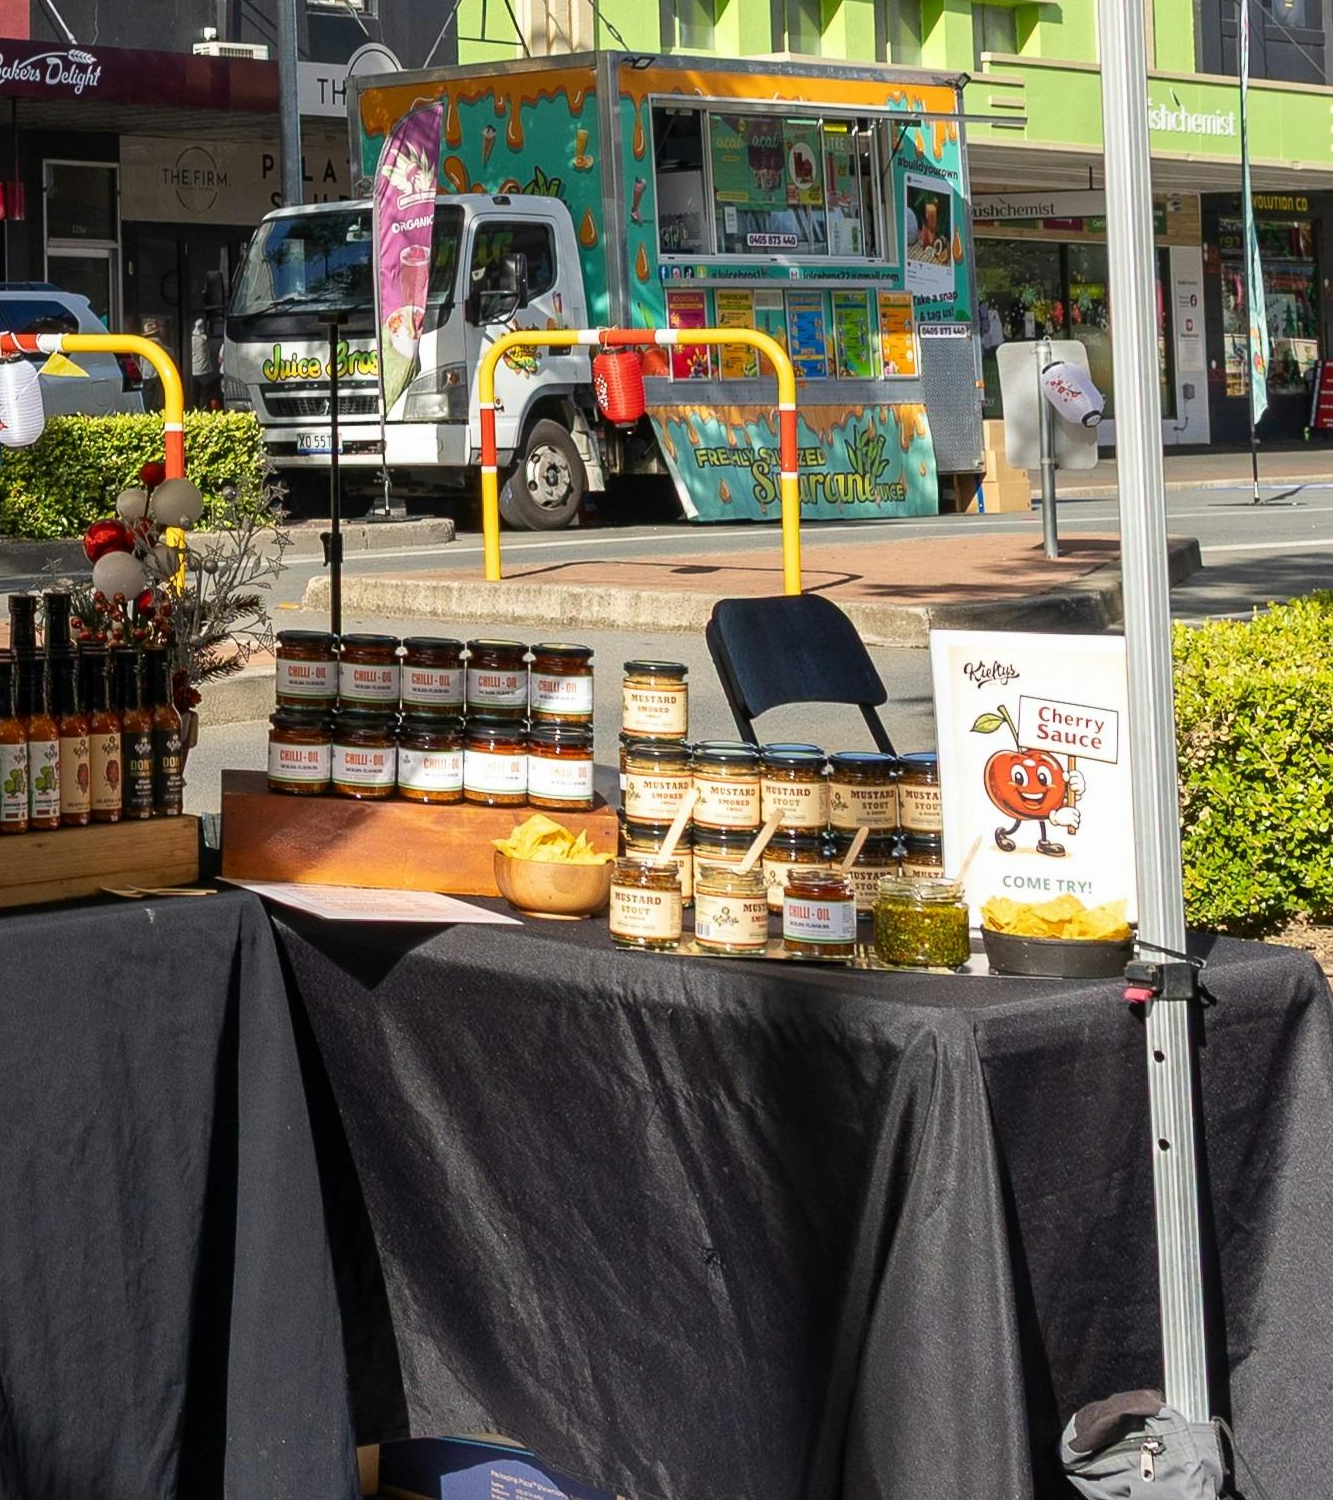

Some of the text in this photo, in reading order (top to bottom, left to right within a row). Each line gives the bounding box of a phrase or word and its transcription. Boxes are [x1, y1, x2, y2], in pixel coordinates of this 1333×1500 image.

[44, 55, 102, 94] Delight
[897, 156, 959, 181] #buildyourown
[972, 202, 1055, 218] ushchemist
[263, 343, 322, 384] Juice
[694, 447, 754, 468] FRESHLY
[288, 666, 326, 679] CHILLI OIL
[412, 673, 450, 686] CHILLI OIL
[963, 660, 1020, 689] Kieltys
[631, 694, 676, 705] MUSTARD
[1038, 706, 1105, 734] Cherry
[1036, 724, 1102, 750] Sauce
[711, 786, 755, 797] MUSTARD
[862, 801, 888, 810] STOUT
[1003, 875, 1093, 894] COME TRY!
[621, 905, 650, 915] STOUT
